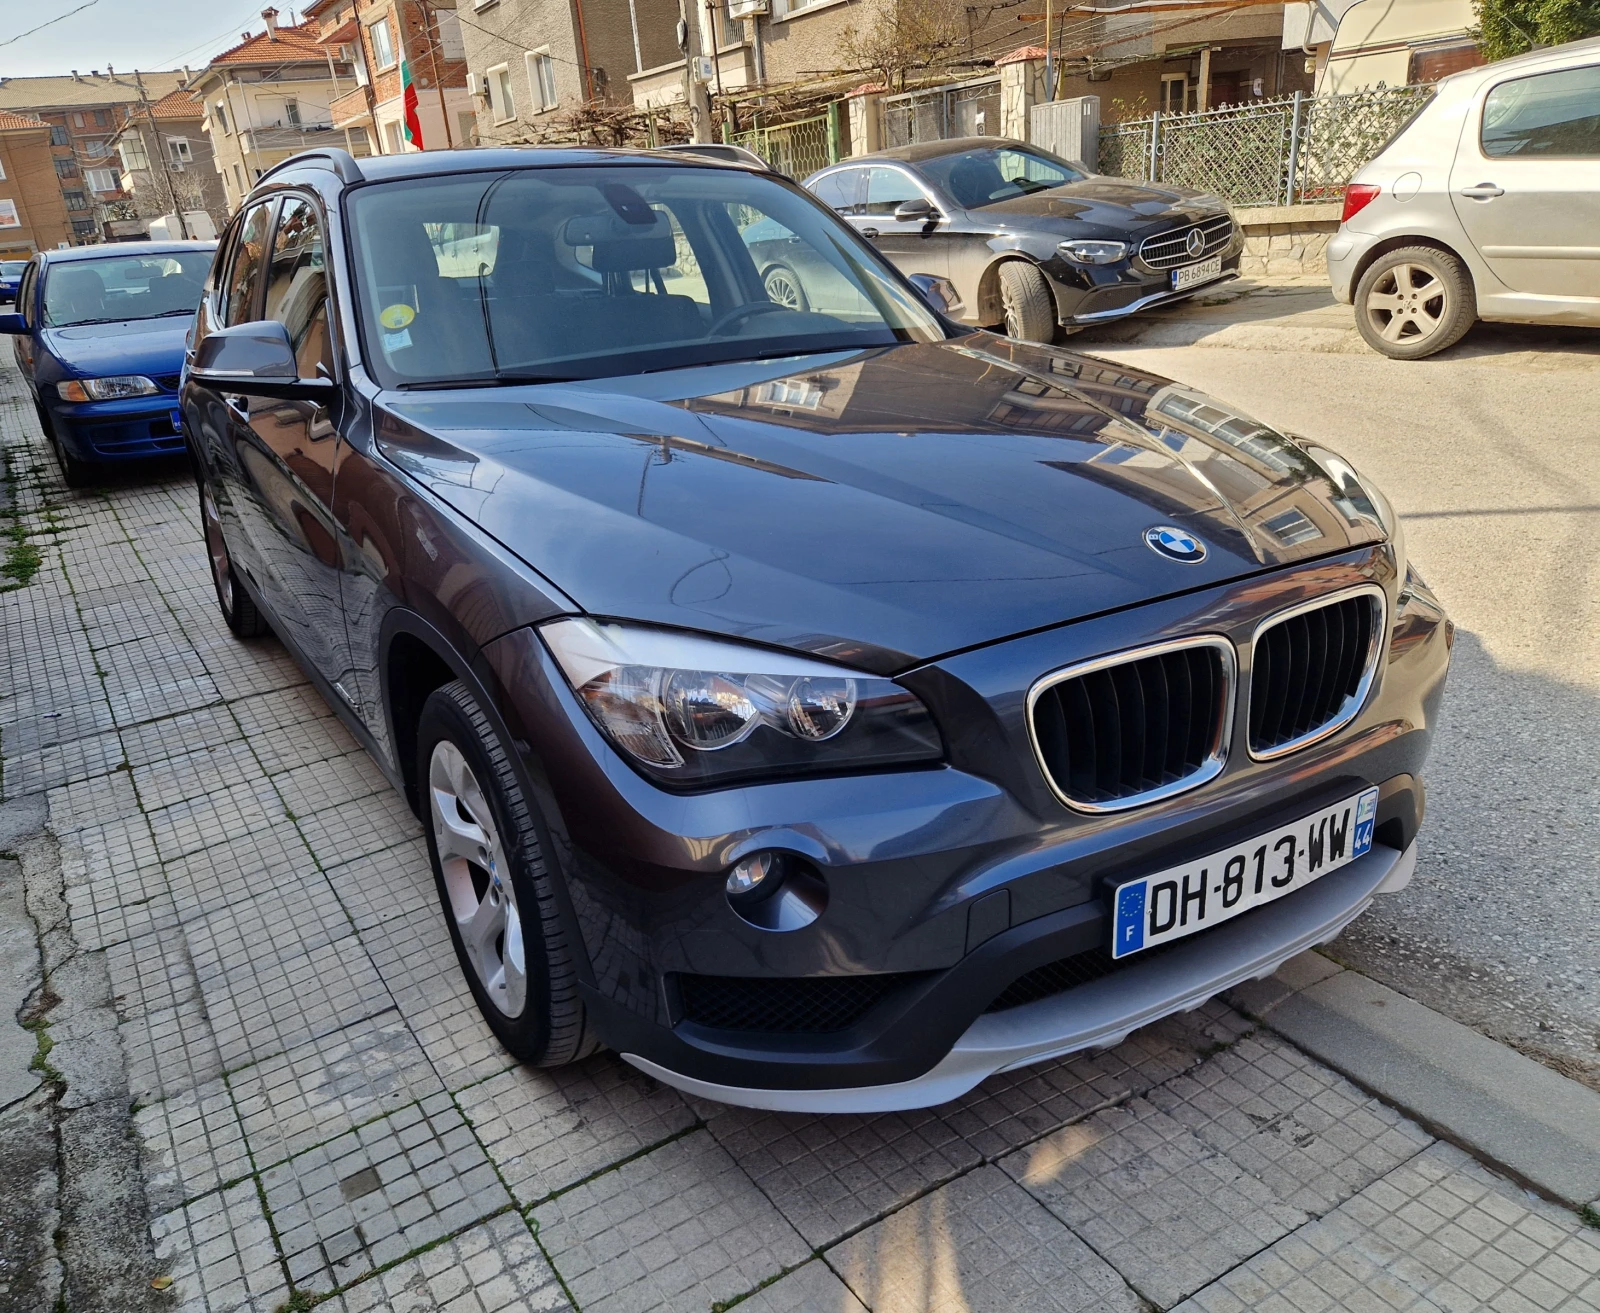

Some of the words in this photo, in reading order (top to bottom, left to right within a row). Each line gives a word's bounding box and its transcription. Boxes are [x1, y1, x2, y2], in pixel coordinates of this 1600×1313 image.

[1354, 823, 1371, 850] 44
[1149, 807, 1351, 937] DH-813-WW
[1125, 924, 1135, 942] F
